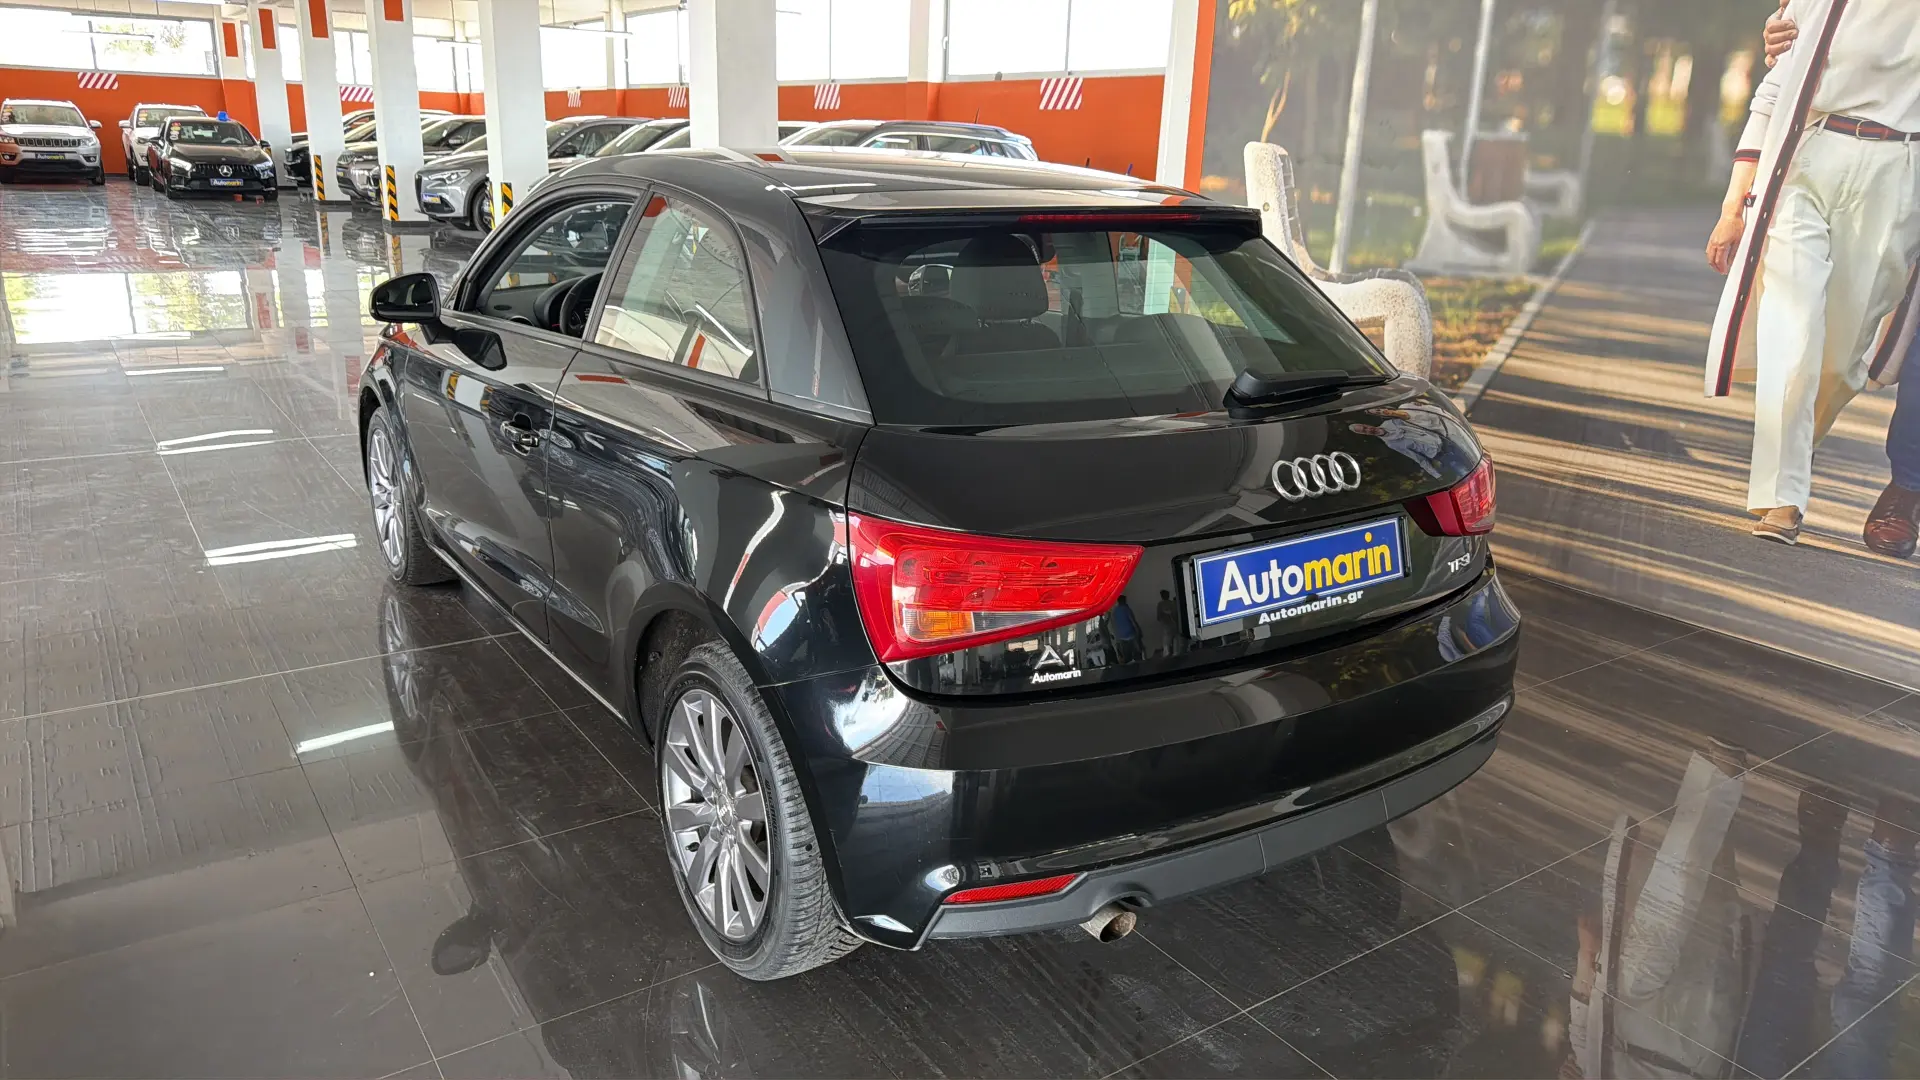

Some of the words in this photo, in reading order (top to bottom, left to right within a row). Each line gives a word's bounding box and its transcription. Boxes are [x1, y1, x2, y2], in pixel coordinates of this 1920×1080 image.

[1217, 531, 1393, 612] Automarin
[1258, 590, 1364, 625] Automarin.gr
[1034, 644, 1075, 670] A1
[1031, 667, 1082, 684] Automarin
